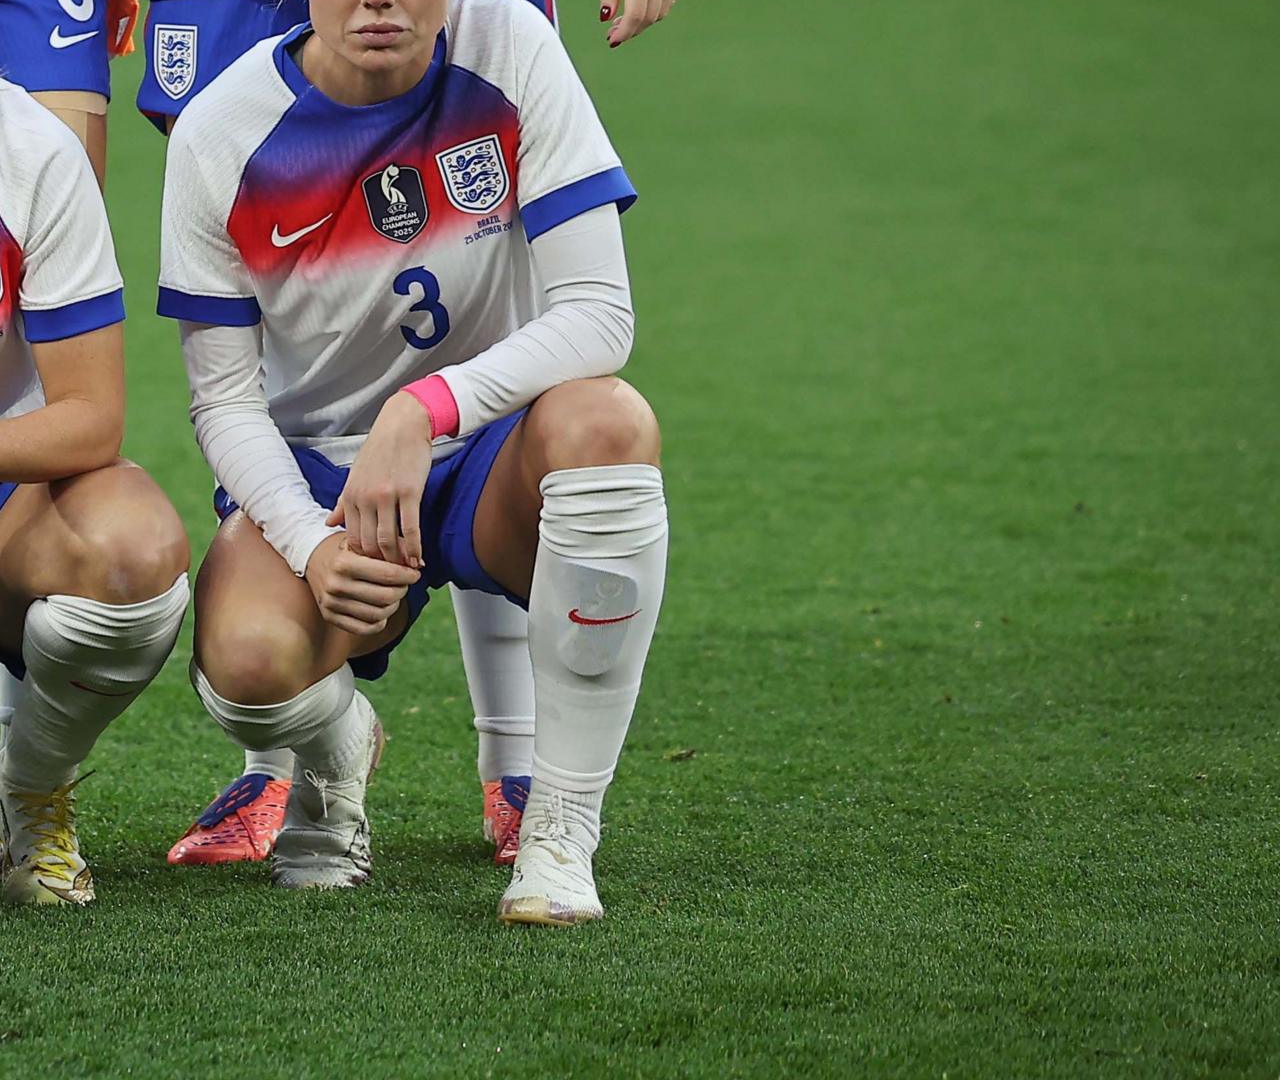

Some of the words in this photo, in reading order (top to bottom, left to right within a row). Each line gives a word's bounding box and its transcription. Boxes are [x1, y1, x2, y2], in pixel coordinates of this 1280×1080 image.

[382, 211, 417, 224] EUROPEAN
[382, 218, 420, 230] CHAMPIONS
[393, 227, 413, 237] 2025
[464, 234, 474, 244] 25
[474, 225, 502, 240] OCTOBER
[393, 265, 450, 350] 3
